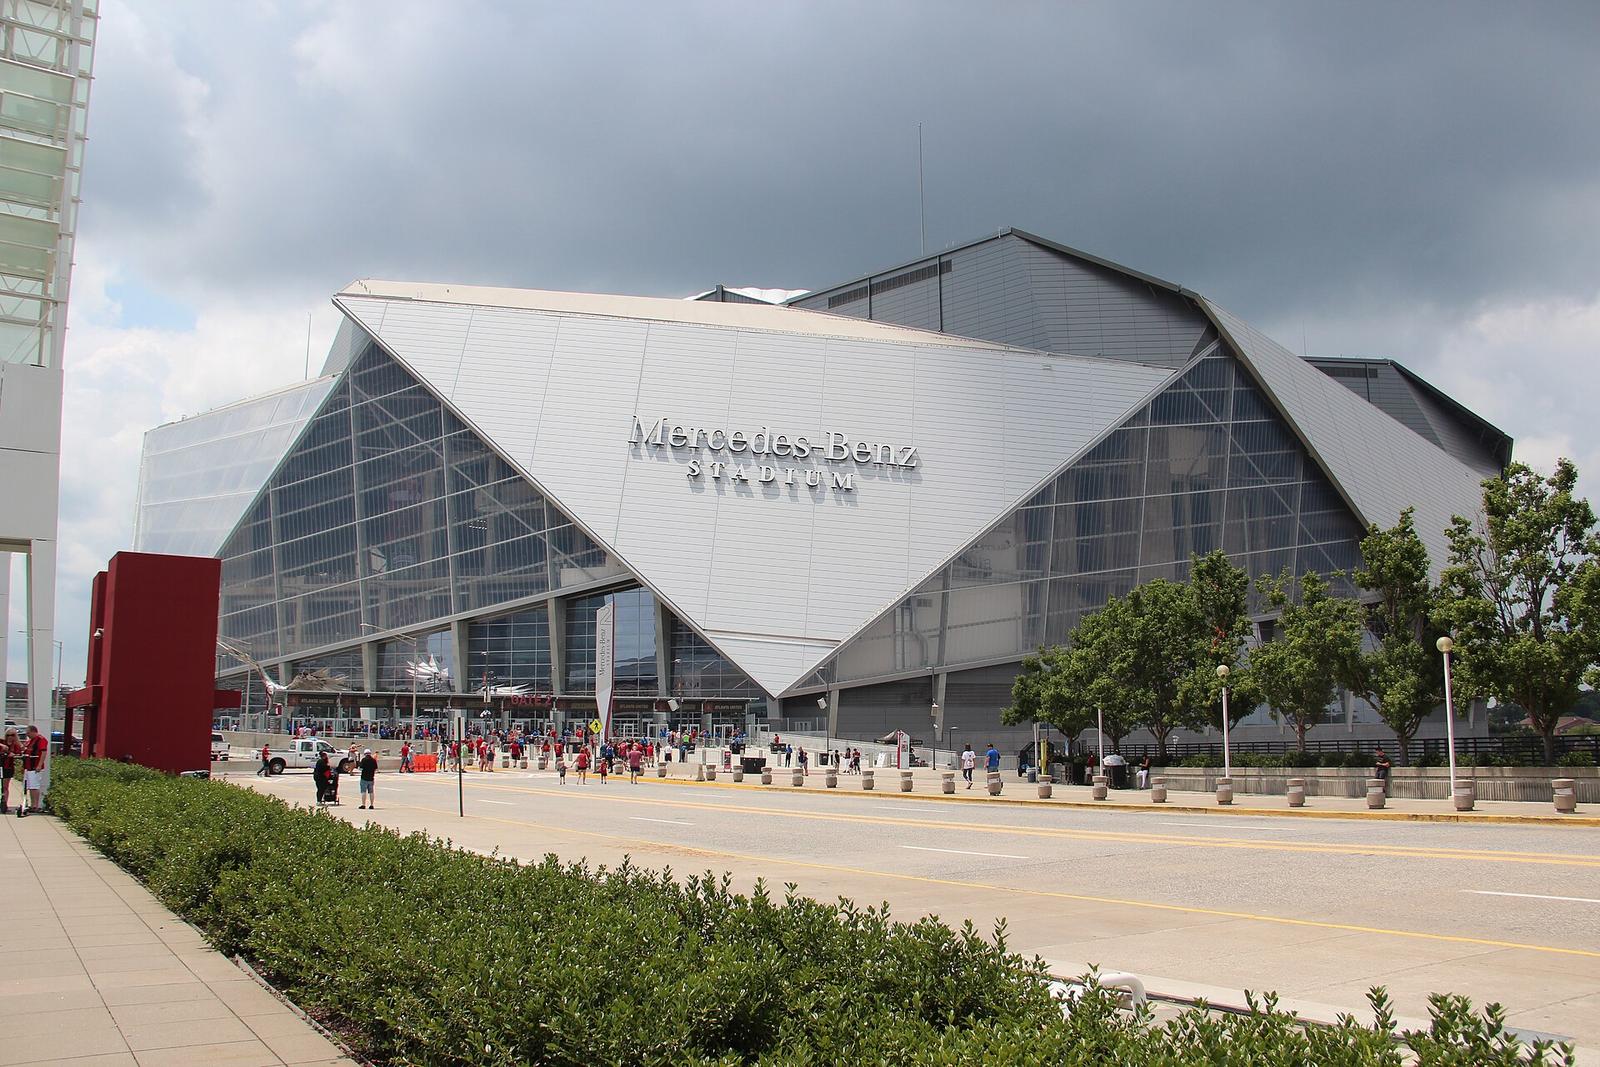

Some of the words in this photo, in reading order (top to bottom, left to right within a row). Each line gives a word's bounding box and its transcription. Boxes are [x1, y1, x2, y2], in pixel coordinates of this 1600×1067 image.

[628, 415, 918, 468] Mercedes-Benz
[687, 459, 853, 489] STADIUM
[511, 694, 541, 704] GATE
[545, 694, 552, 704] 2
